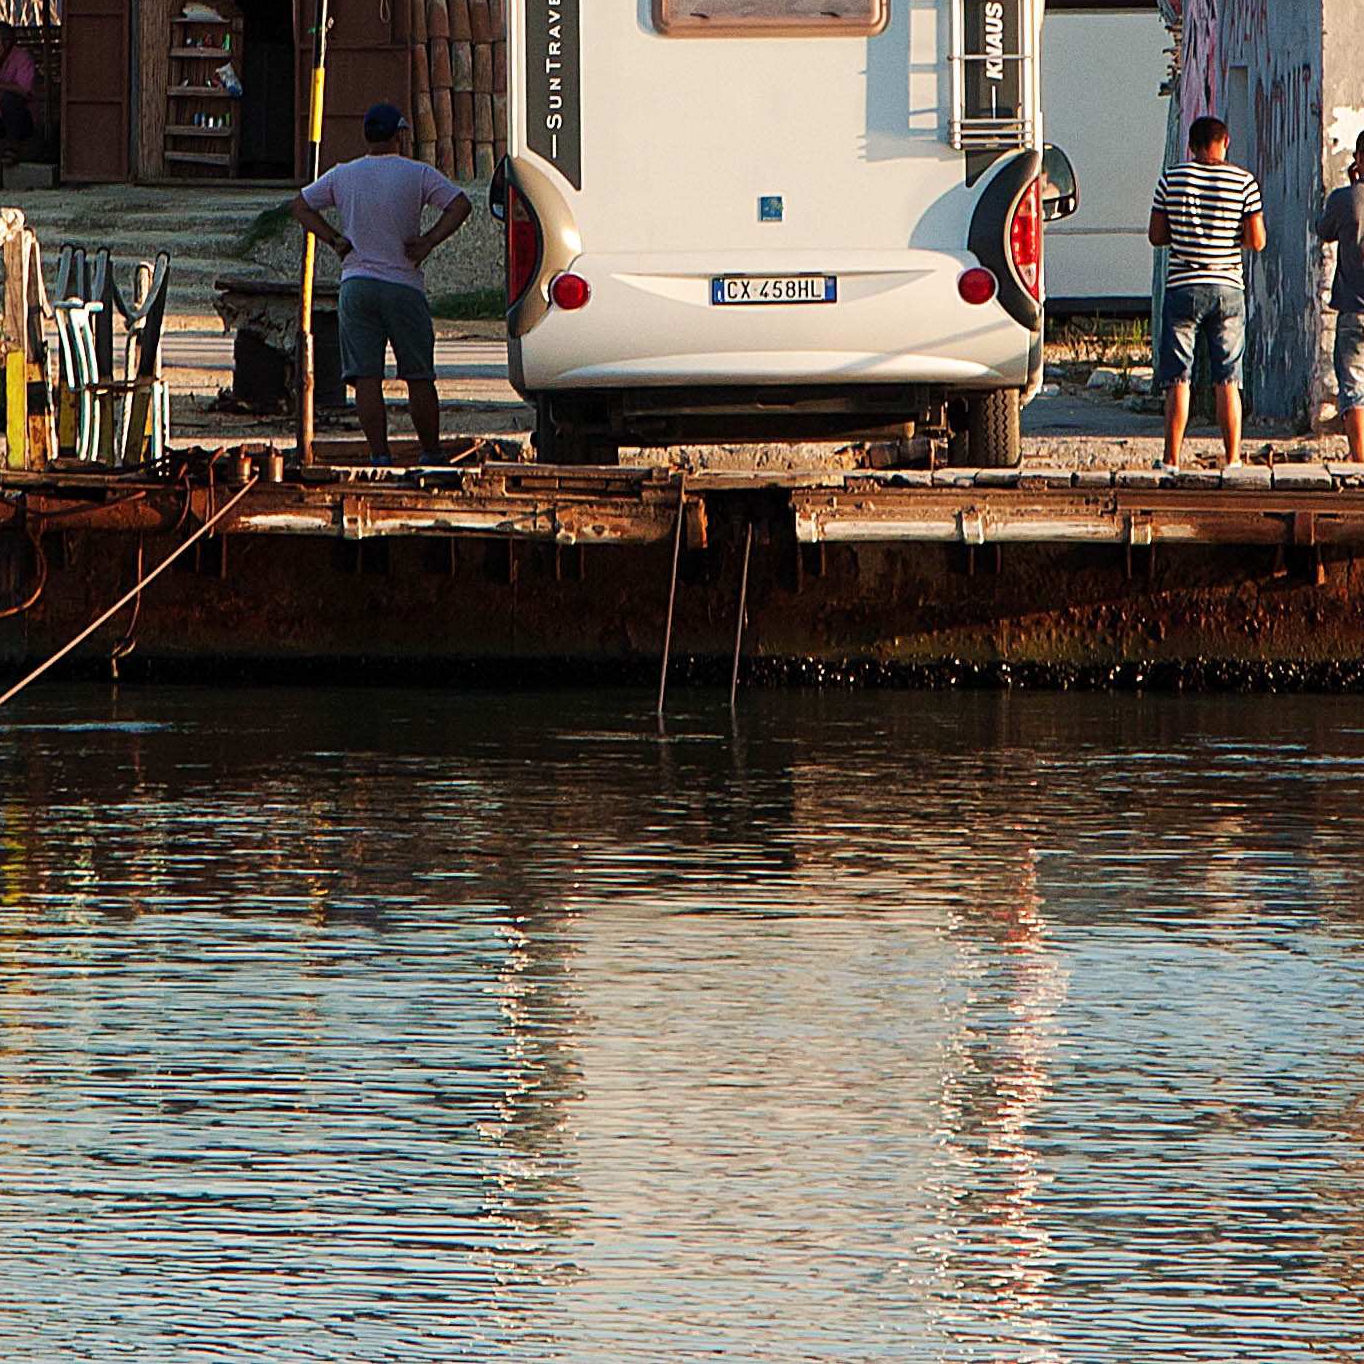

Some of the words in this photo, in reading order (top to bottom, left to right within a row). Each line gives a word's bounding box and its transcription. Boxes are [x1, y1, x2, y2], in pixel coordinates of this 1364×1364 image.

[986, 1, 1003, 81] KNAUS
[727, 280, 751, 299] CX
[759, 280, 822, 298] 458HL
